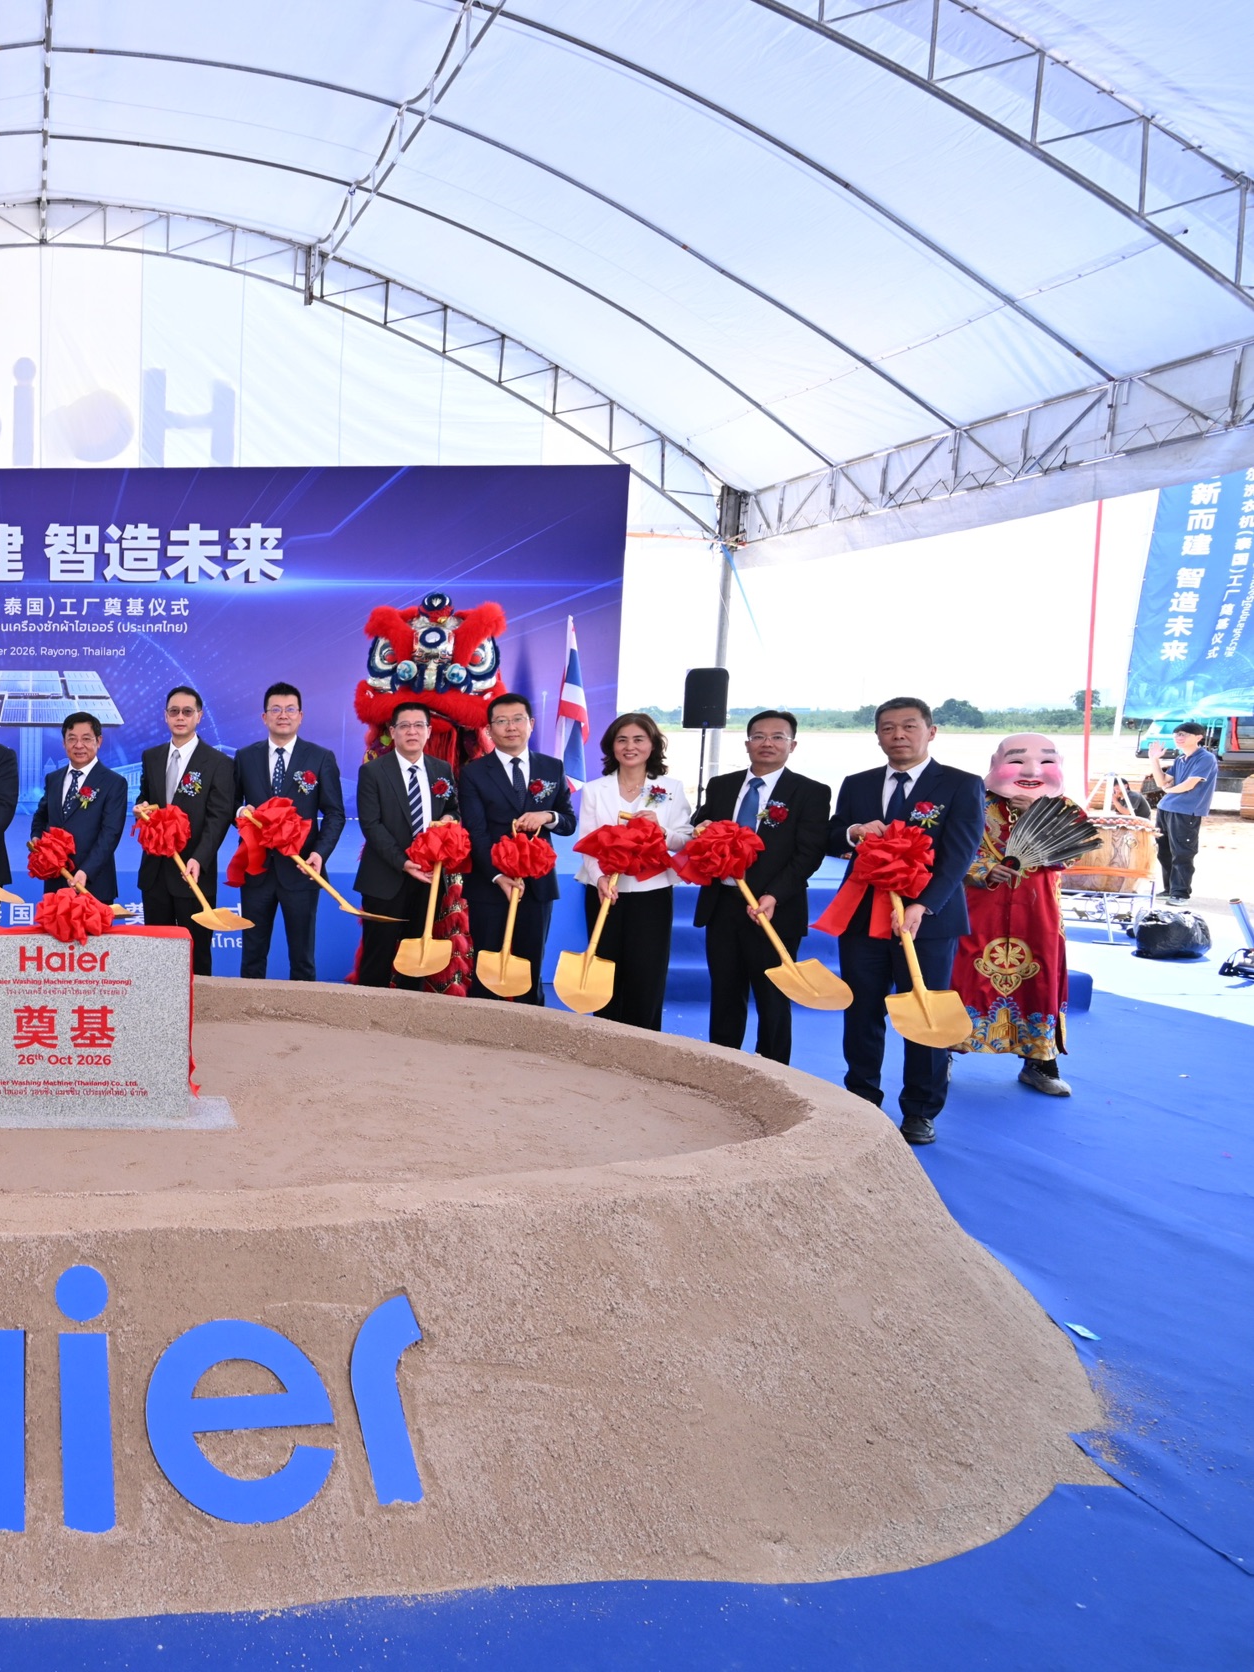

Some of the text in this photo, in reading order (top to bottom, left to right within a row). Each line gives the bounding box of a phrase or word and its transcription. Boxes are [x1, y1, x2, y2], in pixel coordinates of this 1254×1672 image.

[44, 523, 284, 583] 智造未来
[1159, 567, 1205, 661] 智造未来
[117, 621, 188, 634] (ประเทศไทย)
[10, 647, 38, 657] 2026,
[40, 647, 80, 658] Rayong,
[82, 647, 126, 657] Thailand
[19, 944, 110, 973] Haier
[12, 978, 42, 986] Washing
[101, 978, 132, 986] (Rayong)
[13, 1005, 115, 1049] 奠基
[17, 1053, 112, 1065] 26th Oct 2026
